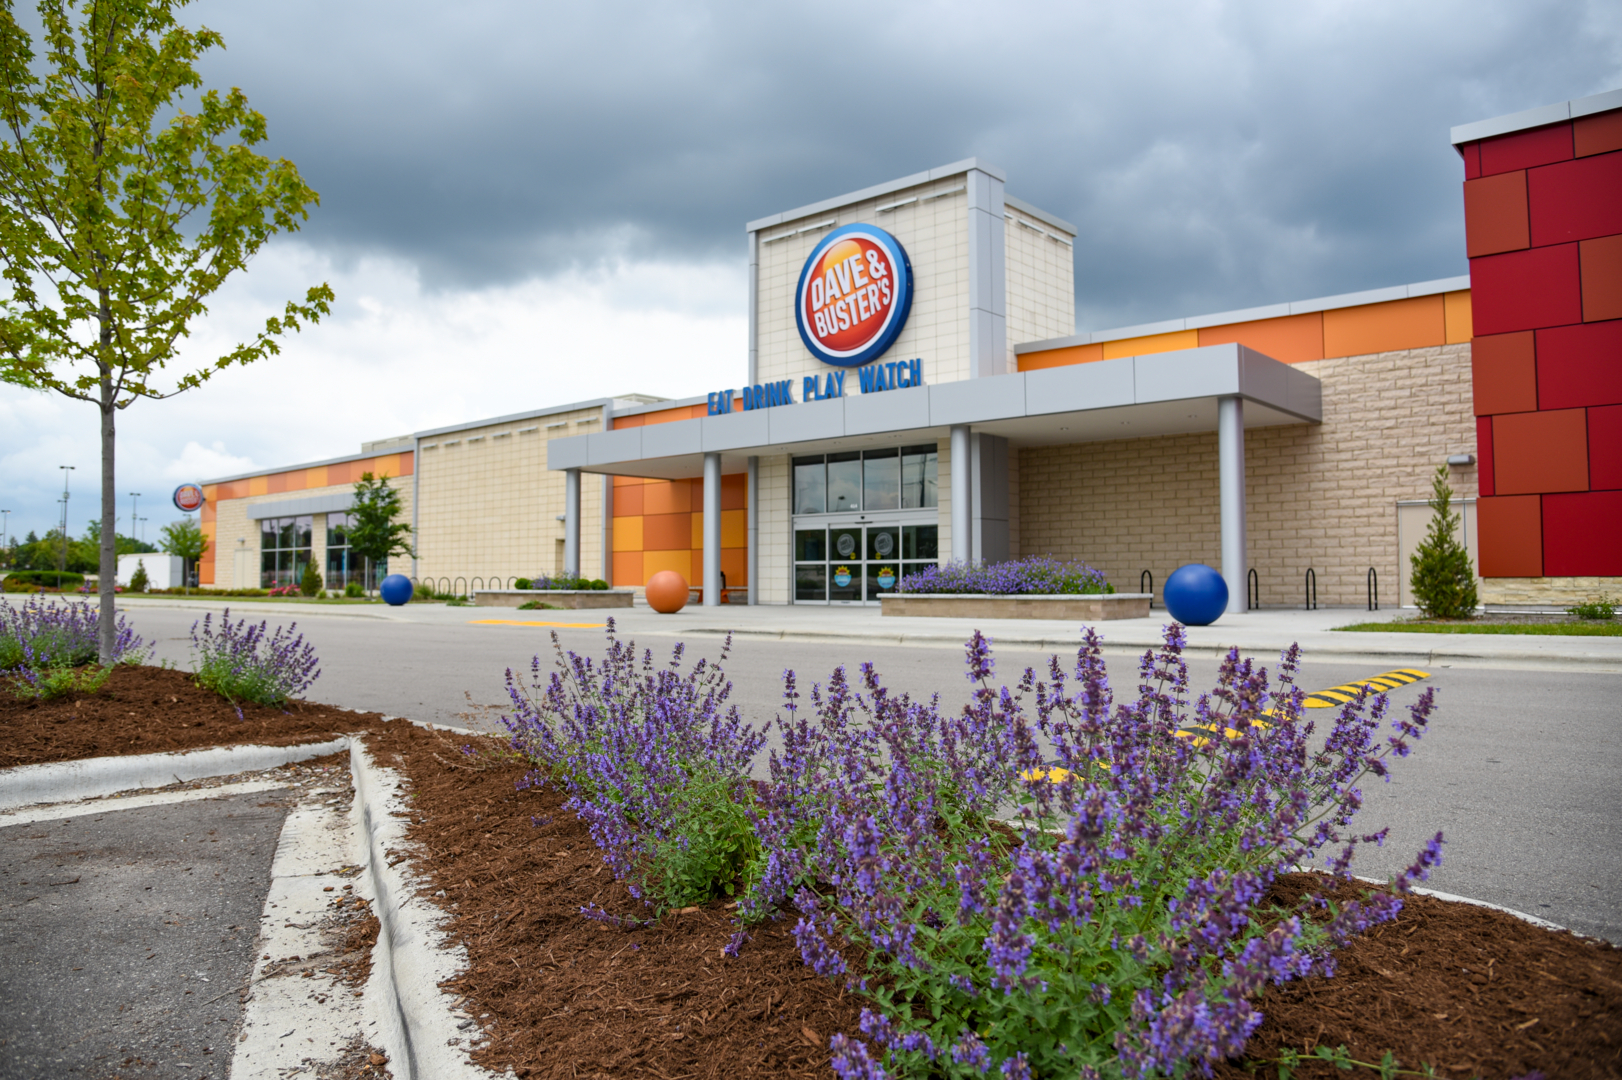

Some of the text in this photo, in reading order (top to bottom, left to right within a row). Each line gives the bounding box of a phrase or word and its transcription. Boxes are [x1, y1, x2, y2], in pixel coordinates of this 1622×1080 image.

[811, 249, 888, 312] DAVE &
[813, 277, 891, 338] BUSTER'S
[707, 358, 922, 416] EAT DRINK PLAY WATCH
